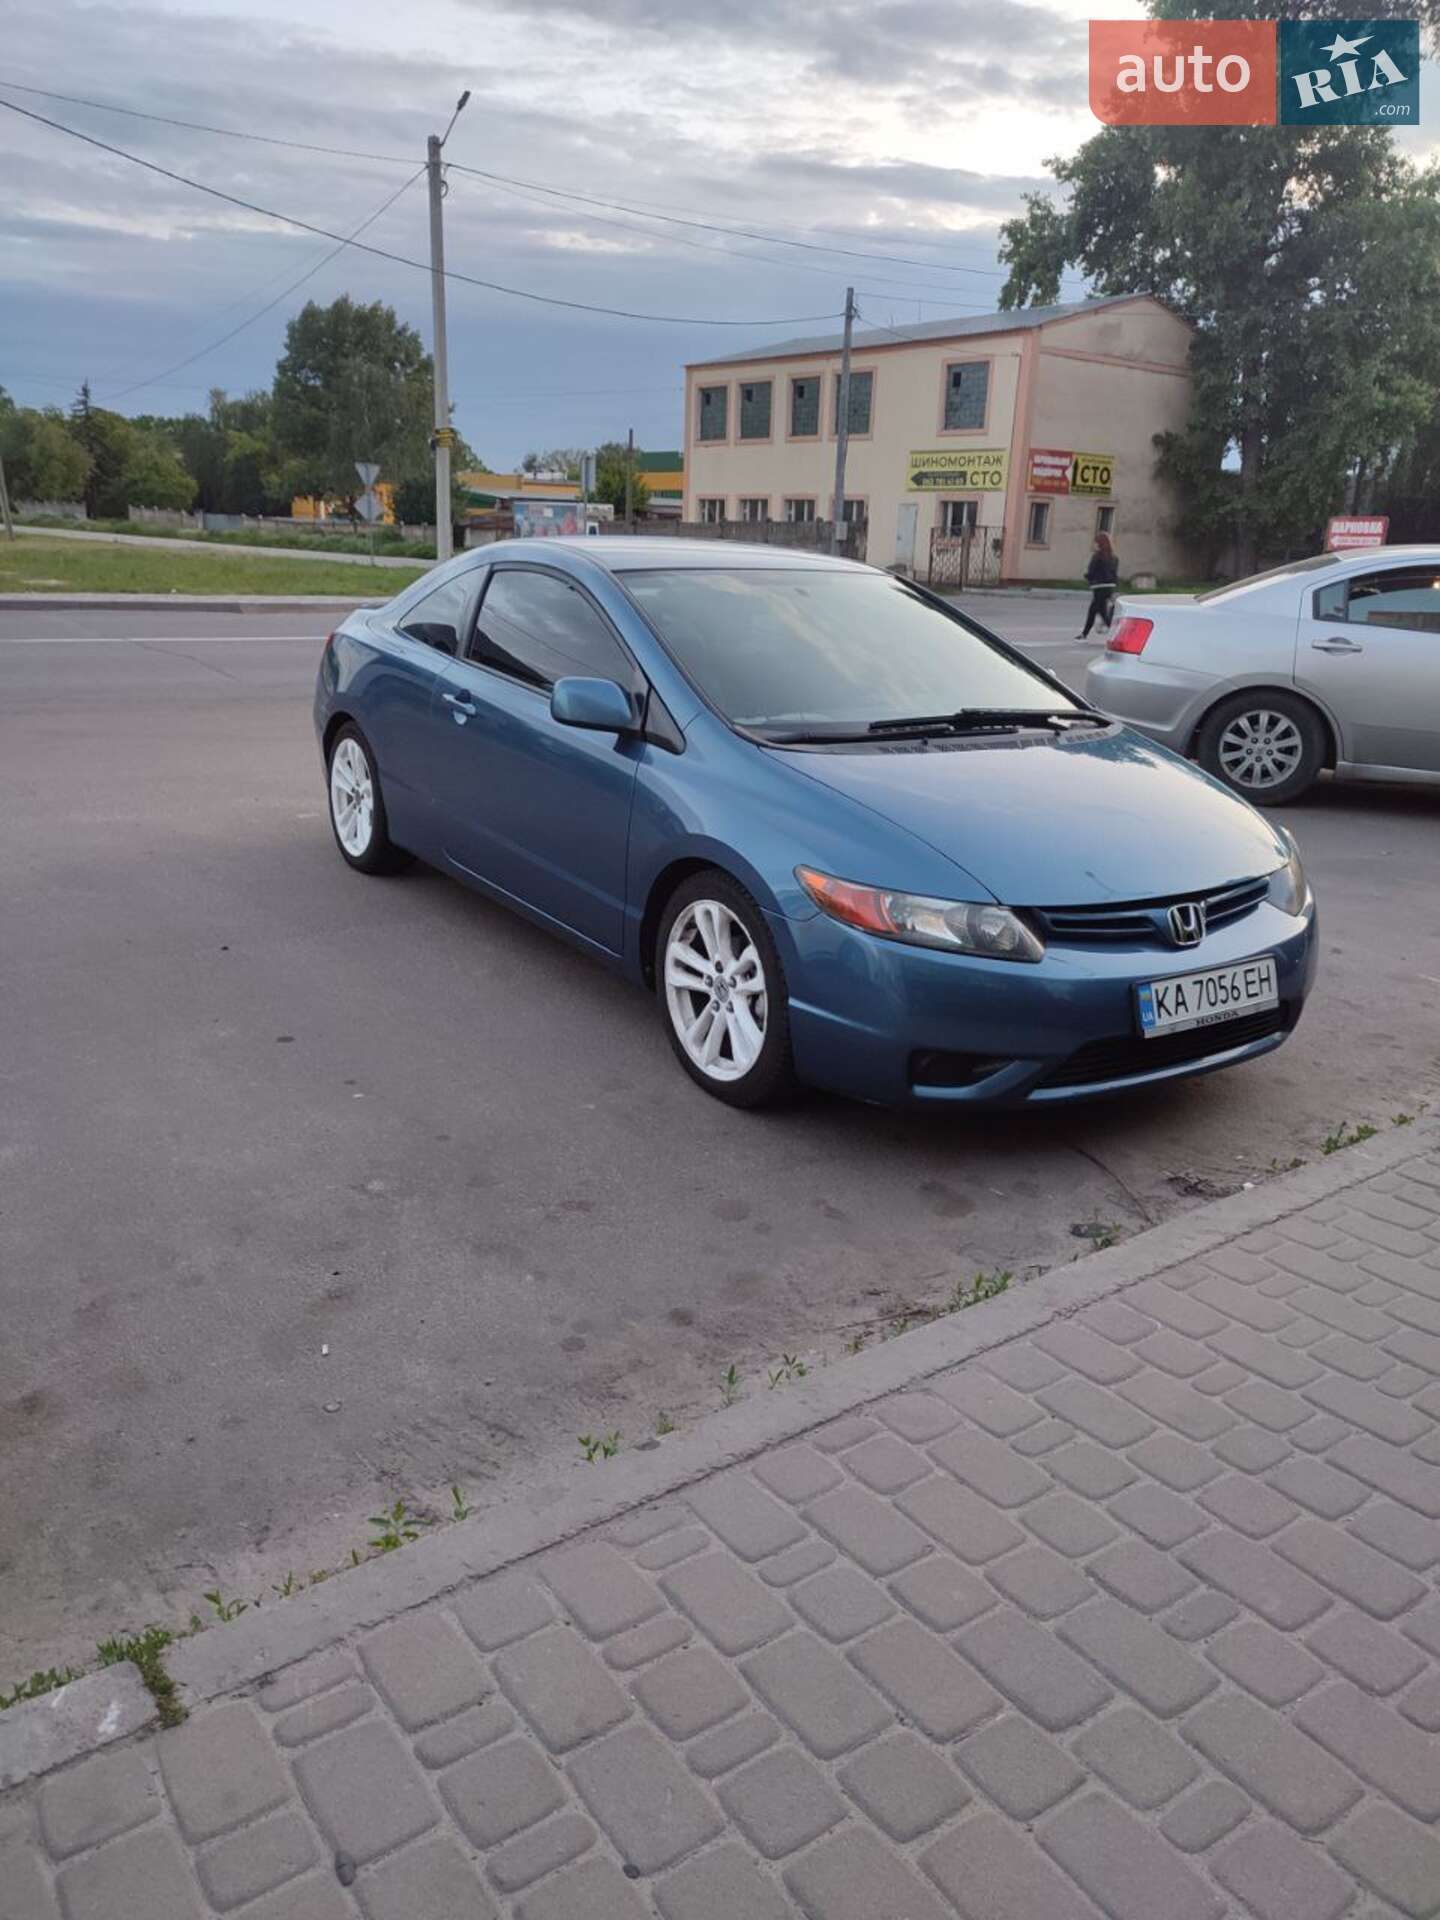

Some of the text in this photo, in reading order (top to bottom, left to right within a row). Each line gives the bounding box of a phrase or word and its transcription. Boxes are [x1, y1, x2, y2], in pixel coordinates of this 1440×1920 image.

[911, 455, 1004, 468] ШИНОМОНТАЖ
[970, 471, 1003, 486] СТО
[1080, 465, 1111, 485] СТО
[1154, 964, 1273, 1019] KA 7056 EH
[1195, 1009, 1240, 1026] HONDA
